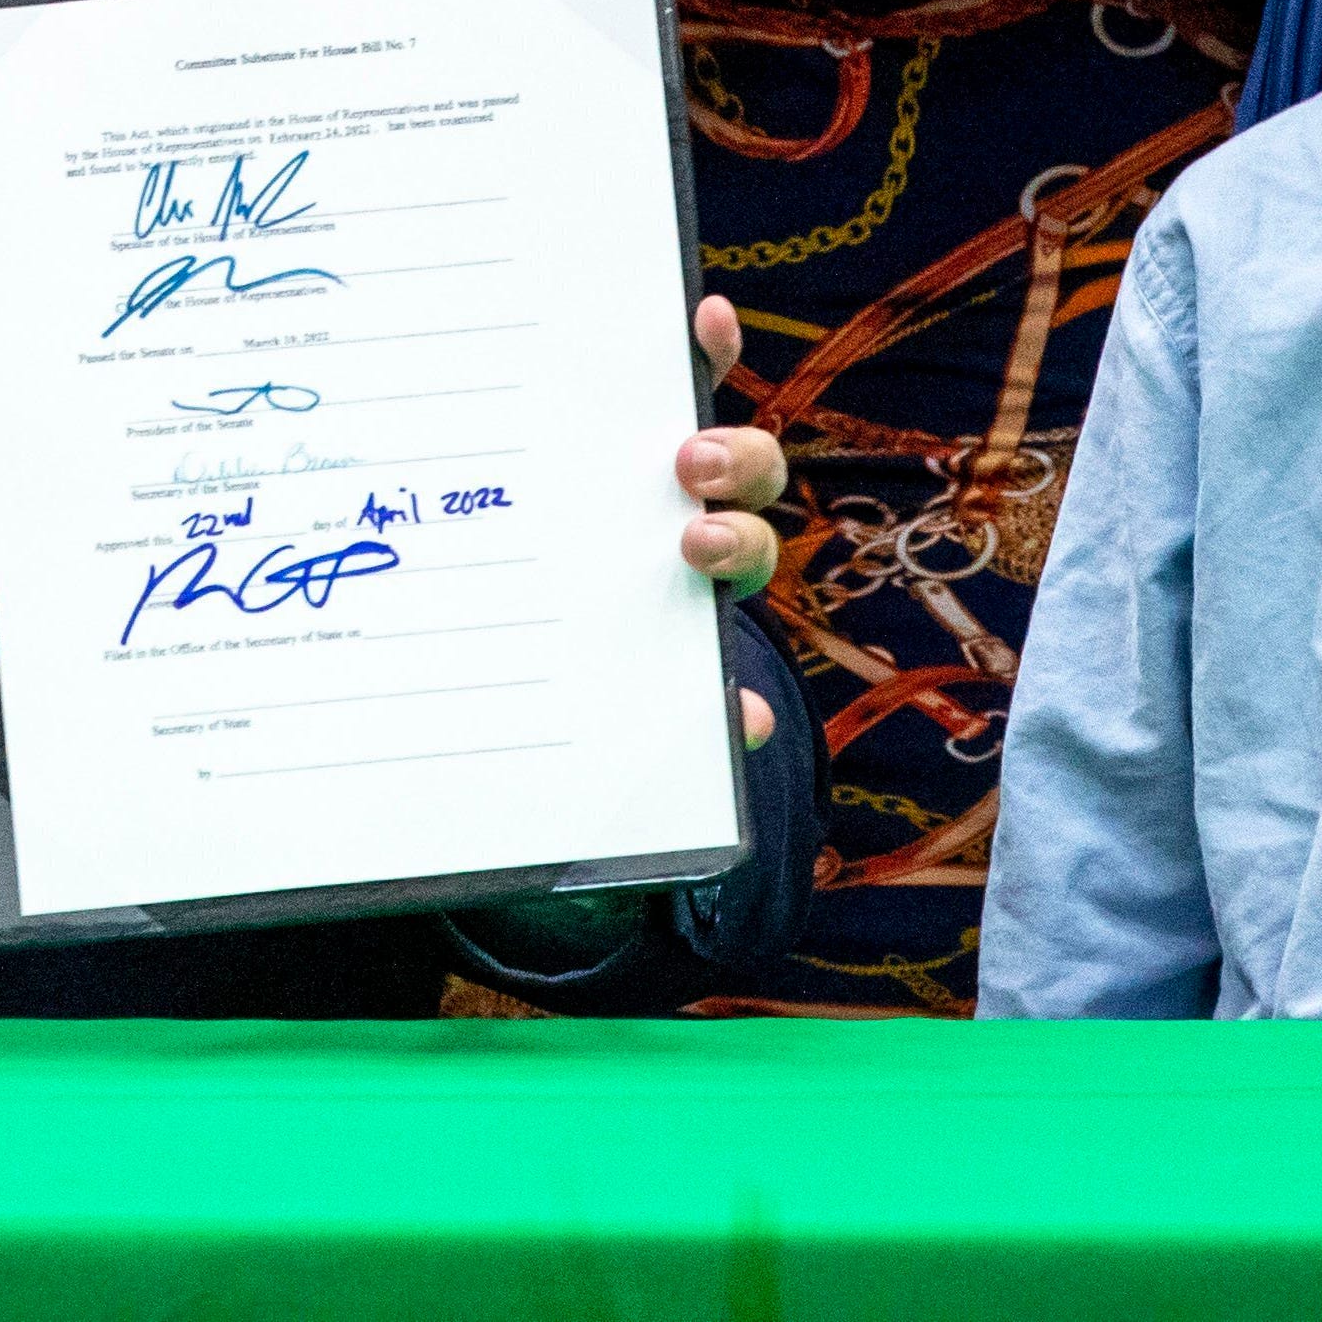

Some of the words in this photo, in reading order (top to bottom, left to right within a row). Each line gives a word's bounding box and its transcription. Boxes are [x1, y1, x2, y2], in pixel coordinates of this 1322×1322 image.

[182, 497, 254, 540] 22nd
[356, 489, 419, 533] April
[443, 487, 513, 516] 2022
